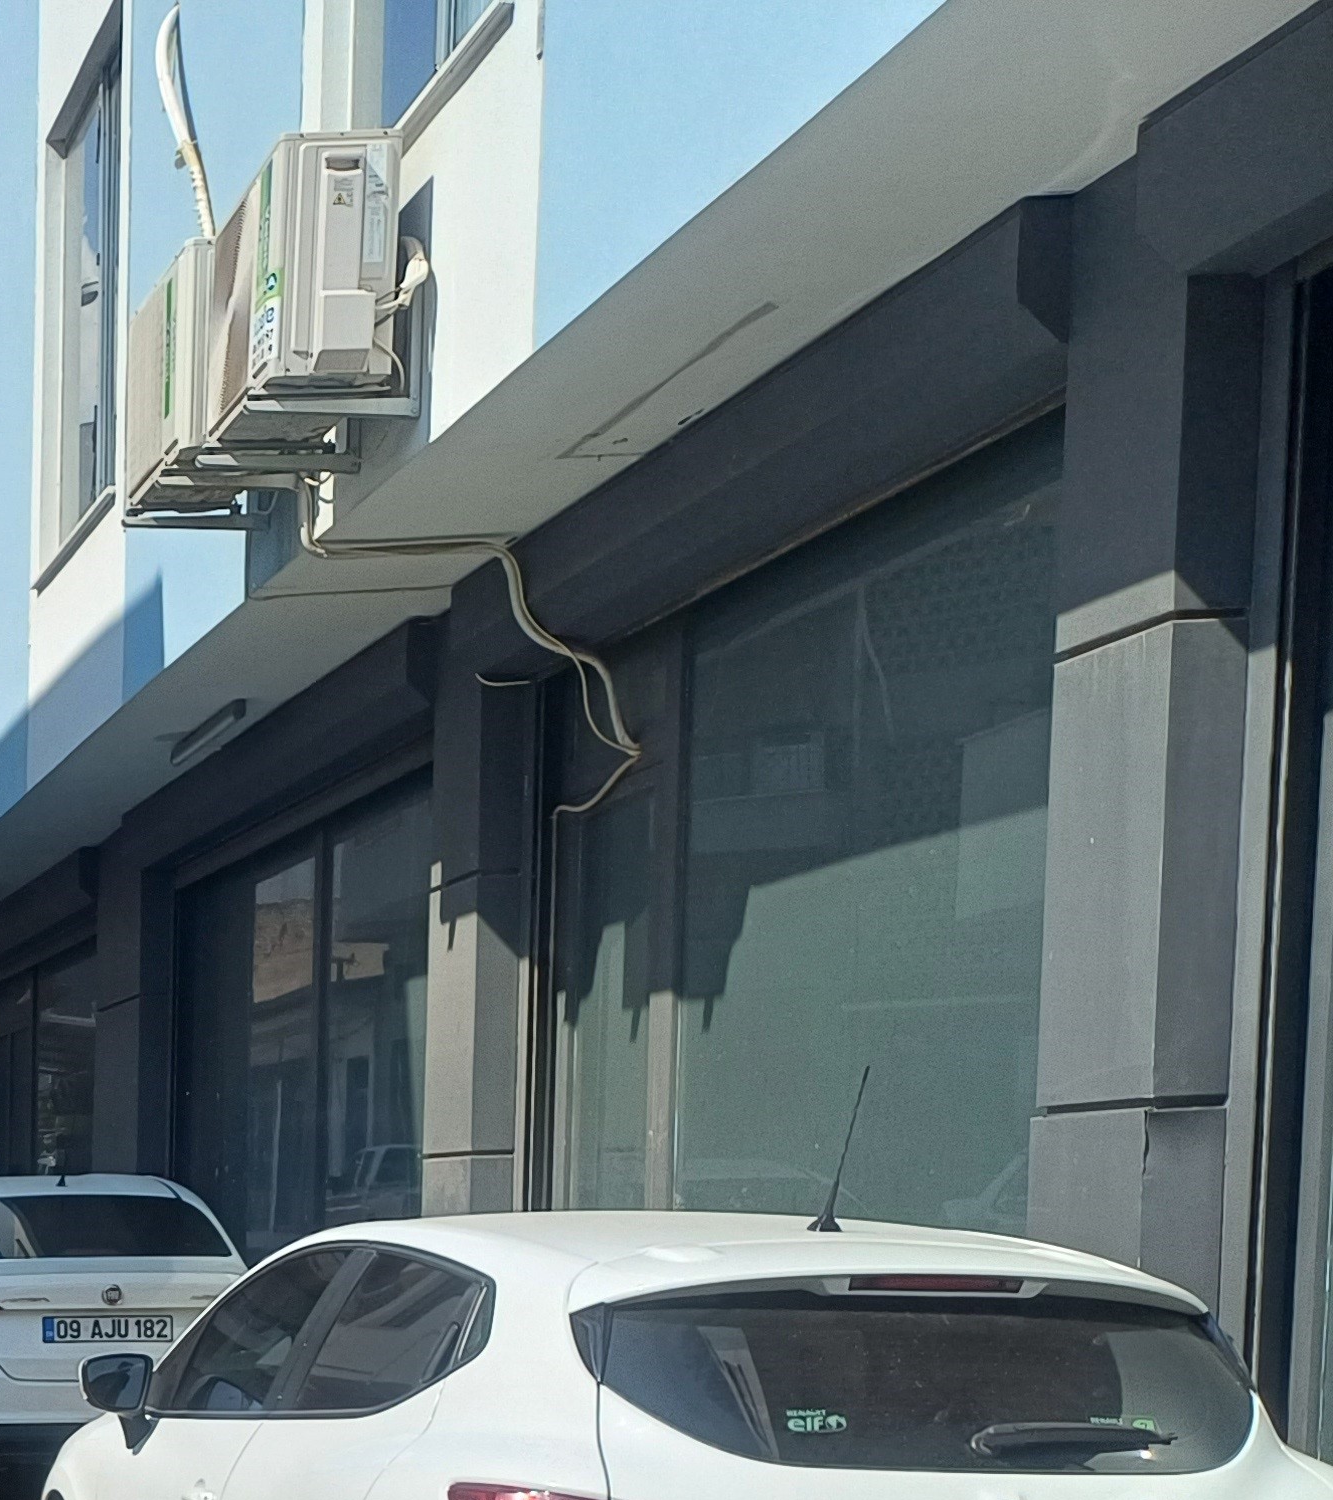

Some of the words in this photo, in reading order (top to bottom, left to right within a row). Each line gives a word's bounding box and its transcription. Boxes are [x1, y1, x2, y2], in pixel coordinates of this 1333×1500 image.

[56, 1320, 81, 1339] 09
[91, 1319, 129, 1338] AJU
[135, 1319, 167, 1338] 182
